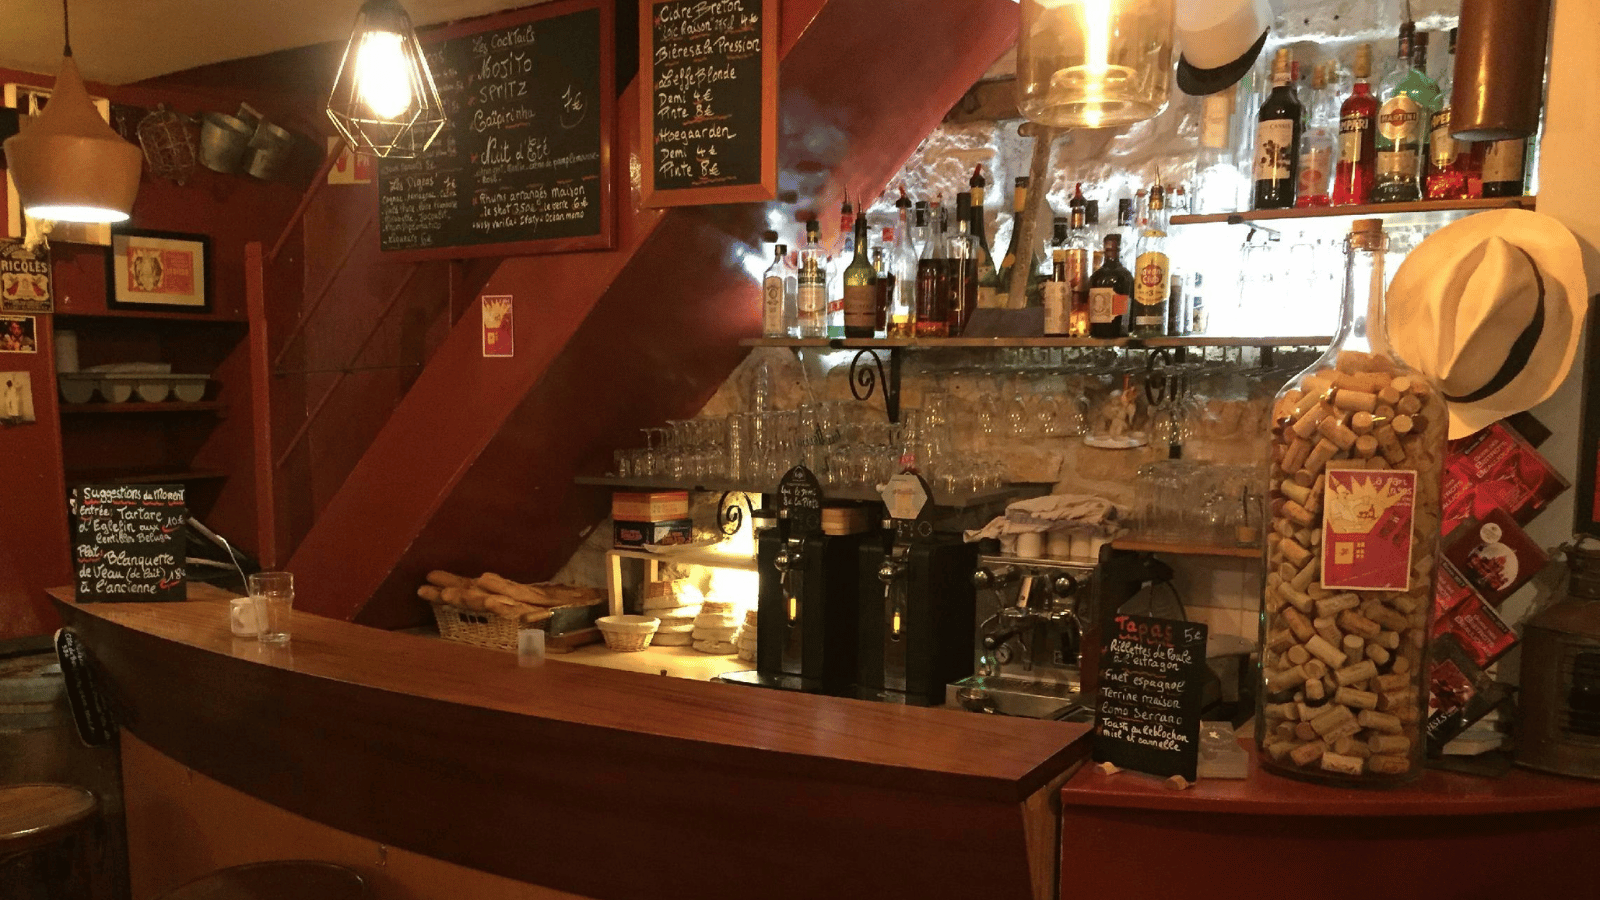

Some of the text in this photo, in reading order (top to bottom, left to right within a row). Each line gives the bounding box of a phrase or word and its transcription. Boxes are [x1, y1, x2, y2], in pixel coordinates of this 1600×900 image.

[660, 5, 693, 22] Cidre
[713, 35, 761, 54] Pression
[695, 63, 737, 87] Blonde
[658, 91, 687, 107] Demi
[657, 105, 689, 120] Pinte
[1381, 112, 1416, 122] MARTINI
[658, 123, 737, 146] Hoegaarden
[660, 148, 687, 163] Demi
[658, 160, 693, 178] Pinte
[116, 505, 163, 522] Tartare
[104, 550, 176, 572] Blanquette
[1114, 615, 1173, 643] Tapas
[1102, 686, 1138, 702] Terrine
